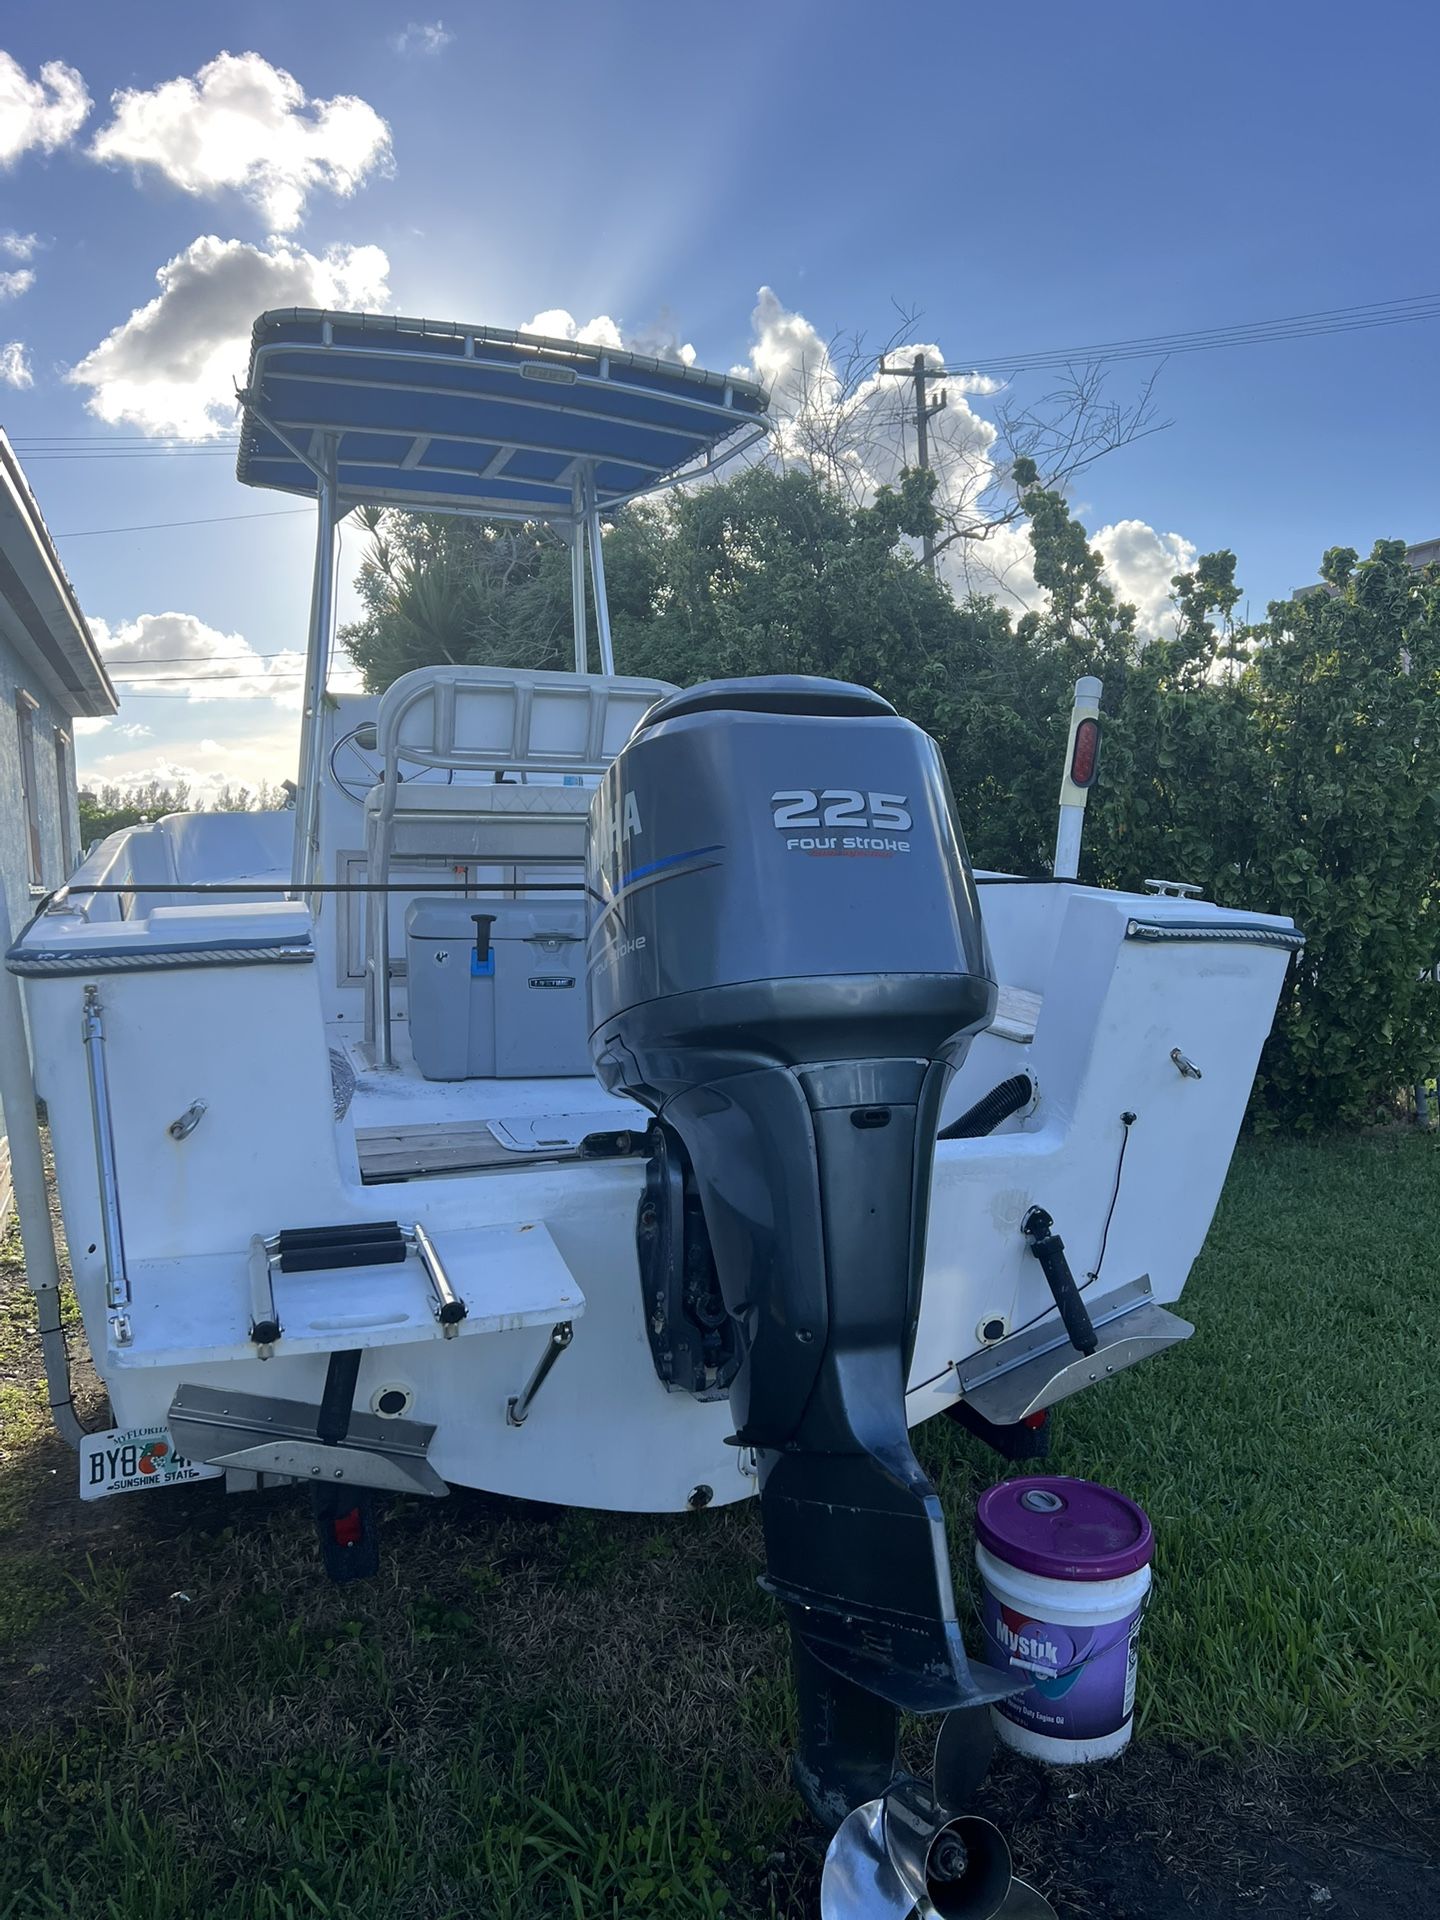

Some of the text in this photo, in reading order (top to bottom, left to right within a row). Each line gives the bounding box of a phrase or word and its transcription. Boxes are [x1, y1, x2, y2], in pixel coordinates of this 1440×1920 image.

[771, 789, 914, 832] 225
[89, 1444, 138, 1485] BY8
[113, 1468, 195, 1490] SUNSHINE STATE
[996, 1618, 1058, 1664] Mystik
[1022, 1706, 1036, 1720] Duty
[1036, 1711, 1055, 1724] Engine
[1055, 1716, 1065, 1725] Oil
